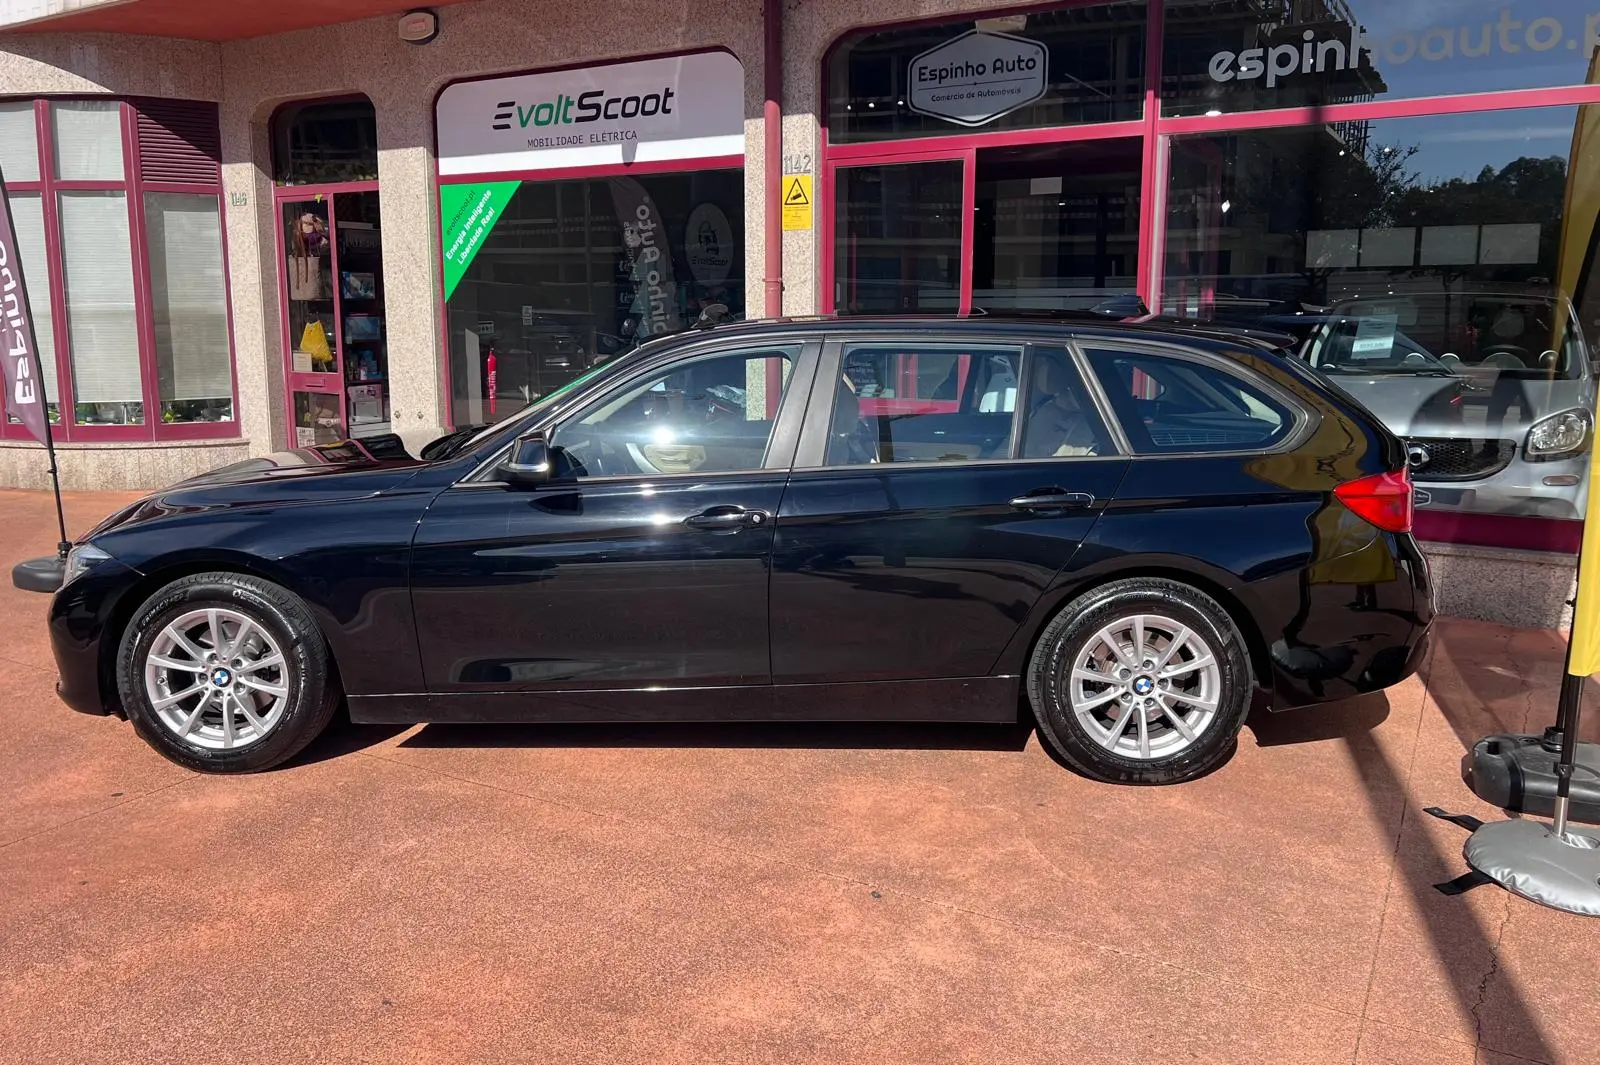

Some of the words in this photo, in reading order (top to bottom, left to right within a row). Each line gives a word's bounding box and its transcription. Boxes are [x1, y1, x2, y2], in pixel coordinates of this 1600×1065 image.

[918, 61, 987, 84] Espinho
[992, 55, 1037, 74] Auto
[492, 87, 674, 130] EvoltScoot
[966, 90, 975, 99] de
[527, 134, 584, 148] MOBILIDADE
[589, 129, 638, 143] ELÉTRICA
[784, 154, 811, 173] 1142
[445, 230, 467, 260] Energia
[464, 189, 492, 231] Inteligente
[457, 226, 484, 265] Liberdade
[480, 207, 496, 228] Real
